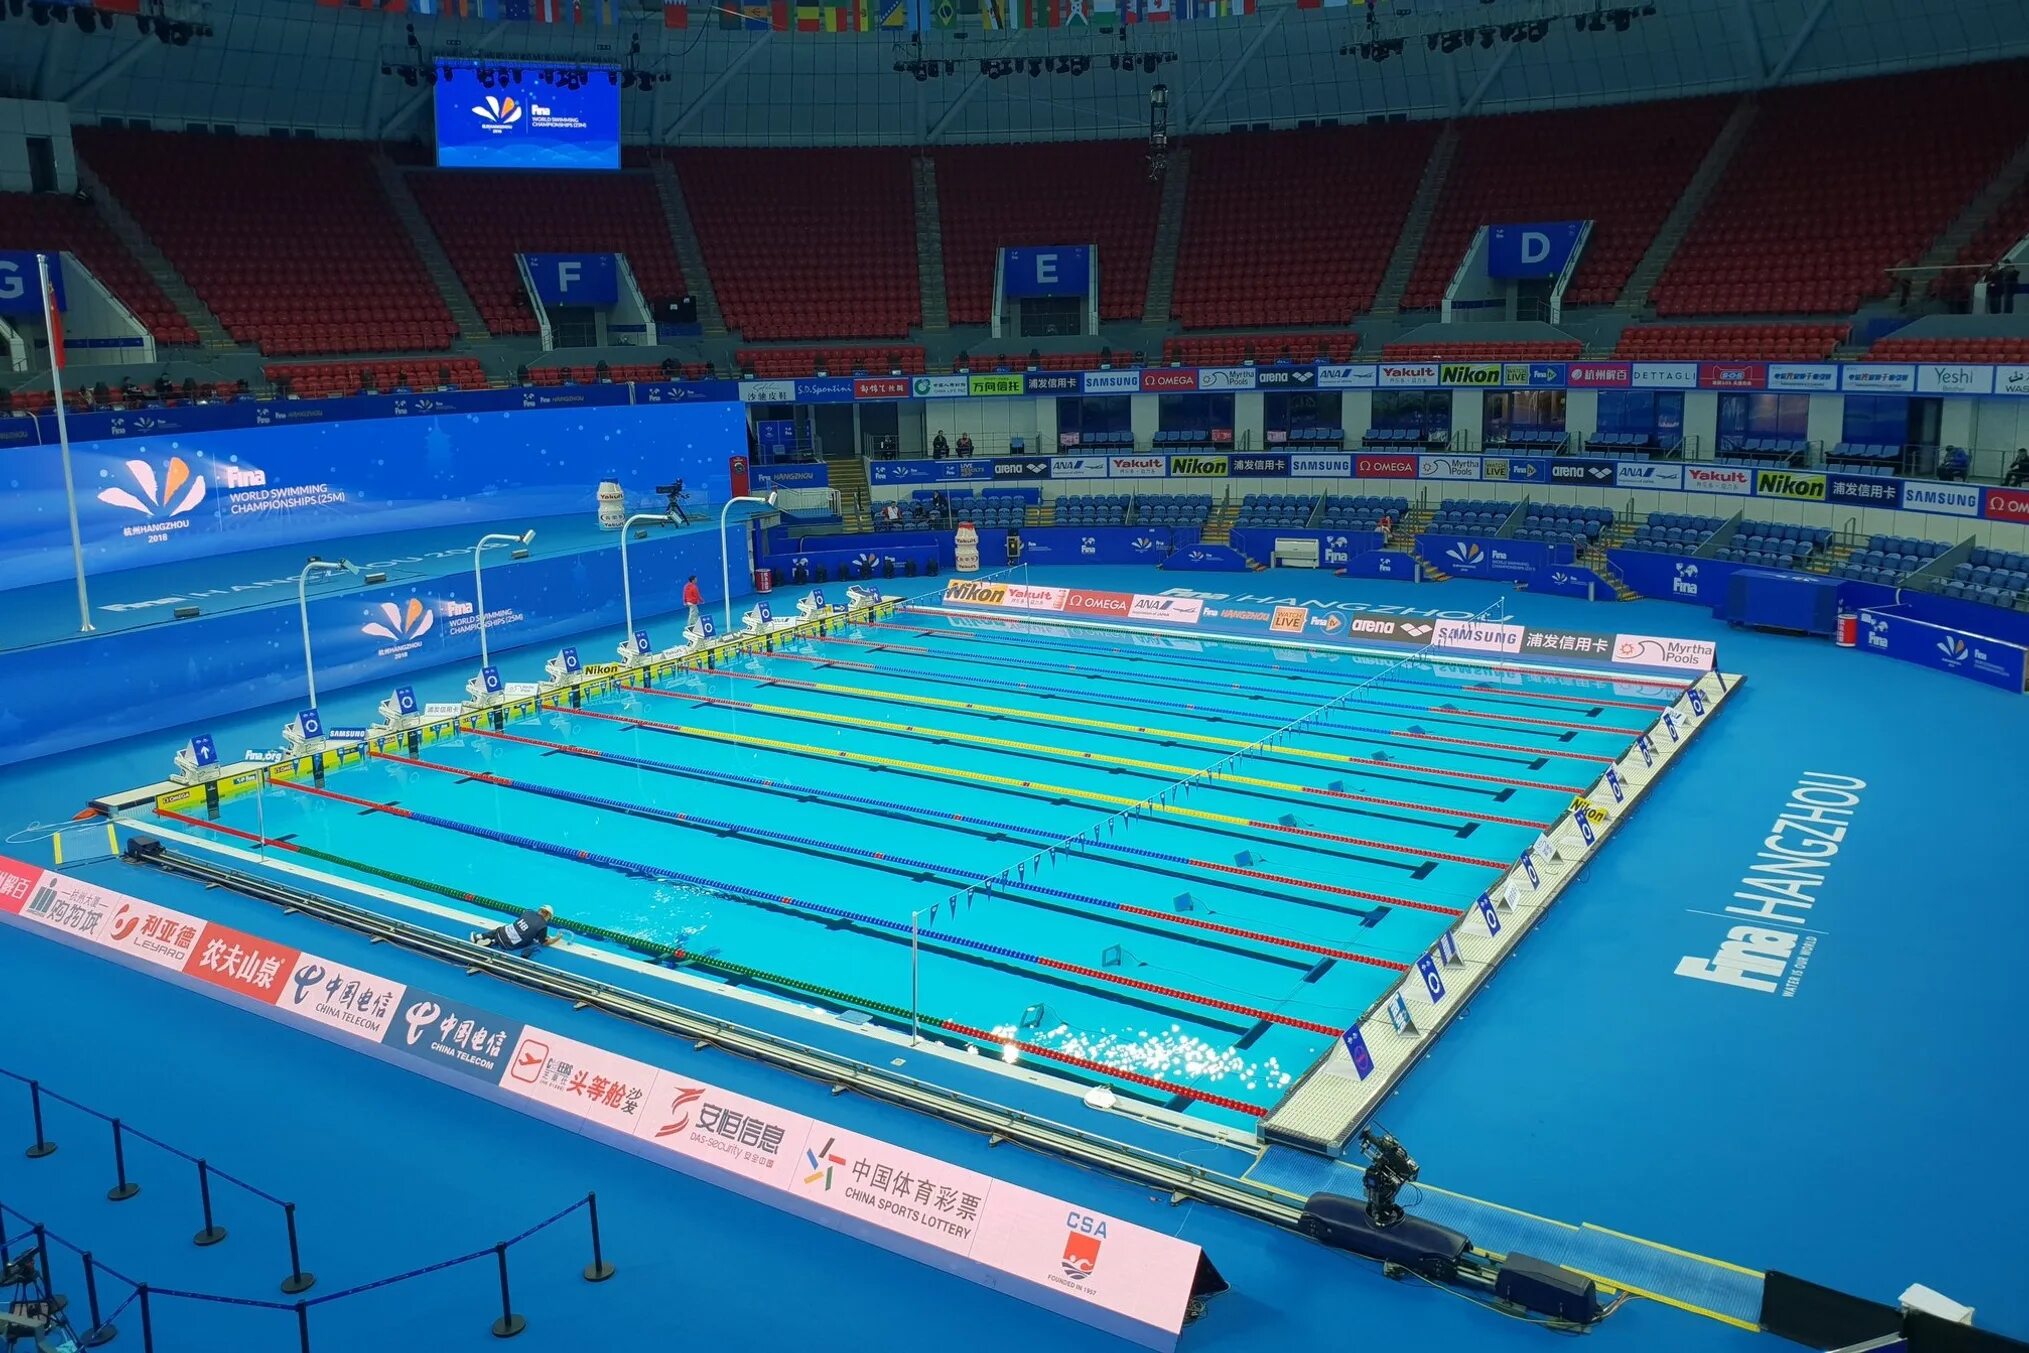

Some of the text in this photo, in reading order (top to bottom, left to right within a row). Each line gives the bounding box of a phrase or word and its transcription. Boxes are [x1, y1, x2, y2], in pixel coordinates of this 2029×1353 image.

[531, 104, 550, 116] Fina
[1521, 232, 1550, 263] D
[1036, 254, 1058, 283] E
[0, 260, 24, 299] G
[558, 262, 581, 292] F
[1229, 370, 1255, 379] Myrtha
[1259, 372, 1289, 383] arena
[1320, 370, 1341, 378] ANA
[1383, 367, 1435, 377] Yakult
[1442, 367, 1499, 383] Nikon
[1507, 373, 1526, 381] LIVE
[1584, 369, 1627, 380] 杭州解百
[1634, 372, 1696, 380] DETTAGLI
[1935, 368, 1973, 384] Yeshi
[974, 382, 1019, 392] 万向信托
[1028, 378, 1077, 388] 浦发信用卡
[1086, 376, 1138, 387] SAMSUNG
[1158, 376, 1194, 385] OMEGA
[1229, 377, 1249, 385] Pools
[994, 464, 1023, 474] arena
[1053, 461, 1074, 469] ANA
[1113, 459, 1163, 468] Yakult
[1172, 458, 1227, 474] Nikon
[1233, 460, 1285, 471] 浦发信用卡
[1293, 461, 1349, 470] SAMSUNG
[1374, 462, 1413, 471] OMEGA
[1451, 459, 1479, 468] Myrtha
[227, 466, 266, 489] Fina
[774, 472, 813, 480] HANGZHOU
[1451, 467, 1472, 476] Pools
[1486, 468, 1505, 476] LIVE
[1552, 466, 1584, 478] arena
[1619, 467, 1643, 477] ANA
[1689, 470, 1748, 483] Yakult
[1759, 474, 1824, 497] Nikon
[1832, 481, 1896, 499] 浦发信用卡
[230, 483, 328, 503] WORLD SWIMMING
[1906, 489, 1976, 507] SAMSUNG
[230, 491, 345, 514] CHAMPIONSHIPS (25M)
[148, 533, 168, 543] 2018
[1325, 548, 1348, 562] Fina
[1673, 577, 1697, 594] Fina
[946, 582, 1005, 603] Nikon
[1009, 588, 1052, 600] Yakult
[449, 601, 473, 617] Fina
[1085, 598, 1126, 610] OMEGA
[1135, 600, 1159, 609] ANA
[506, 614, 523, 623] (25M)
[1203, 607, 1269, 620] Fina HANGZHOU
[1277, 611, 1303, 619] WATCH
[450, 616, 475, 627] WORLD
[1275, 618, 1300, 628] LIVE
[1352, 619, 1394, 634] arena
[1438, 627, 1517, 644] SAMSUNG
[1868, 631, 1888, 648] Fina
[1526, 633, 1608, 653] 浦发信用卡
[1668, 642, 1712, 656] Myrtha
[1666, 652, 1699, 664] Pools
[585, 665, 618, 675] Nikon
[330, 730, 365, 739] SAMSUNG
[1725, 771, 1866, 924] HANGZHOU
[141, 915, 197, 950] 利亚德
[134, 937, 185, 961] LEYARD
[200, 938, 282, 990] 农夫山泉
[1674, 925, 1799, 993] Fina
[1782, 976, 1801, 997] WATER
[326, 974, 393, 1019] 中国电信
[316, 1003, 380, 1032] CHINA TELECOM
[440, 1013, 507, 1057] 中国电信
[431, 1042, 494, 1071] CHINA TELECOM
[566, 1070, 626, 1109] 头等舱
[695, 1102, 785, 1155] 安恒信息
[851, 1158, 982, 1221] 中国体育彩票
[845, 1187, 971, 1240] CHINA SPORTS LOTTERY
[1066, 1211, 1107, 1239] CSA
[1048, 1274, 1075, 1288] FOUNDED
[1083, 1287, 1097, 1296] 1957
